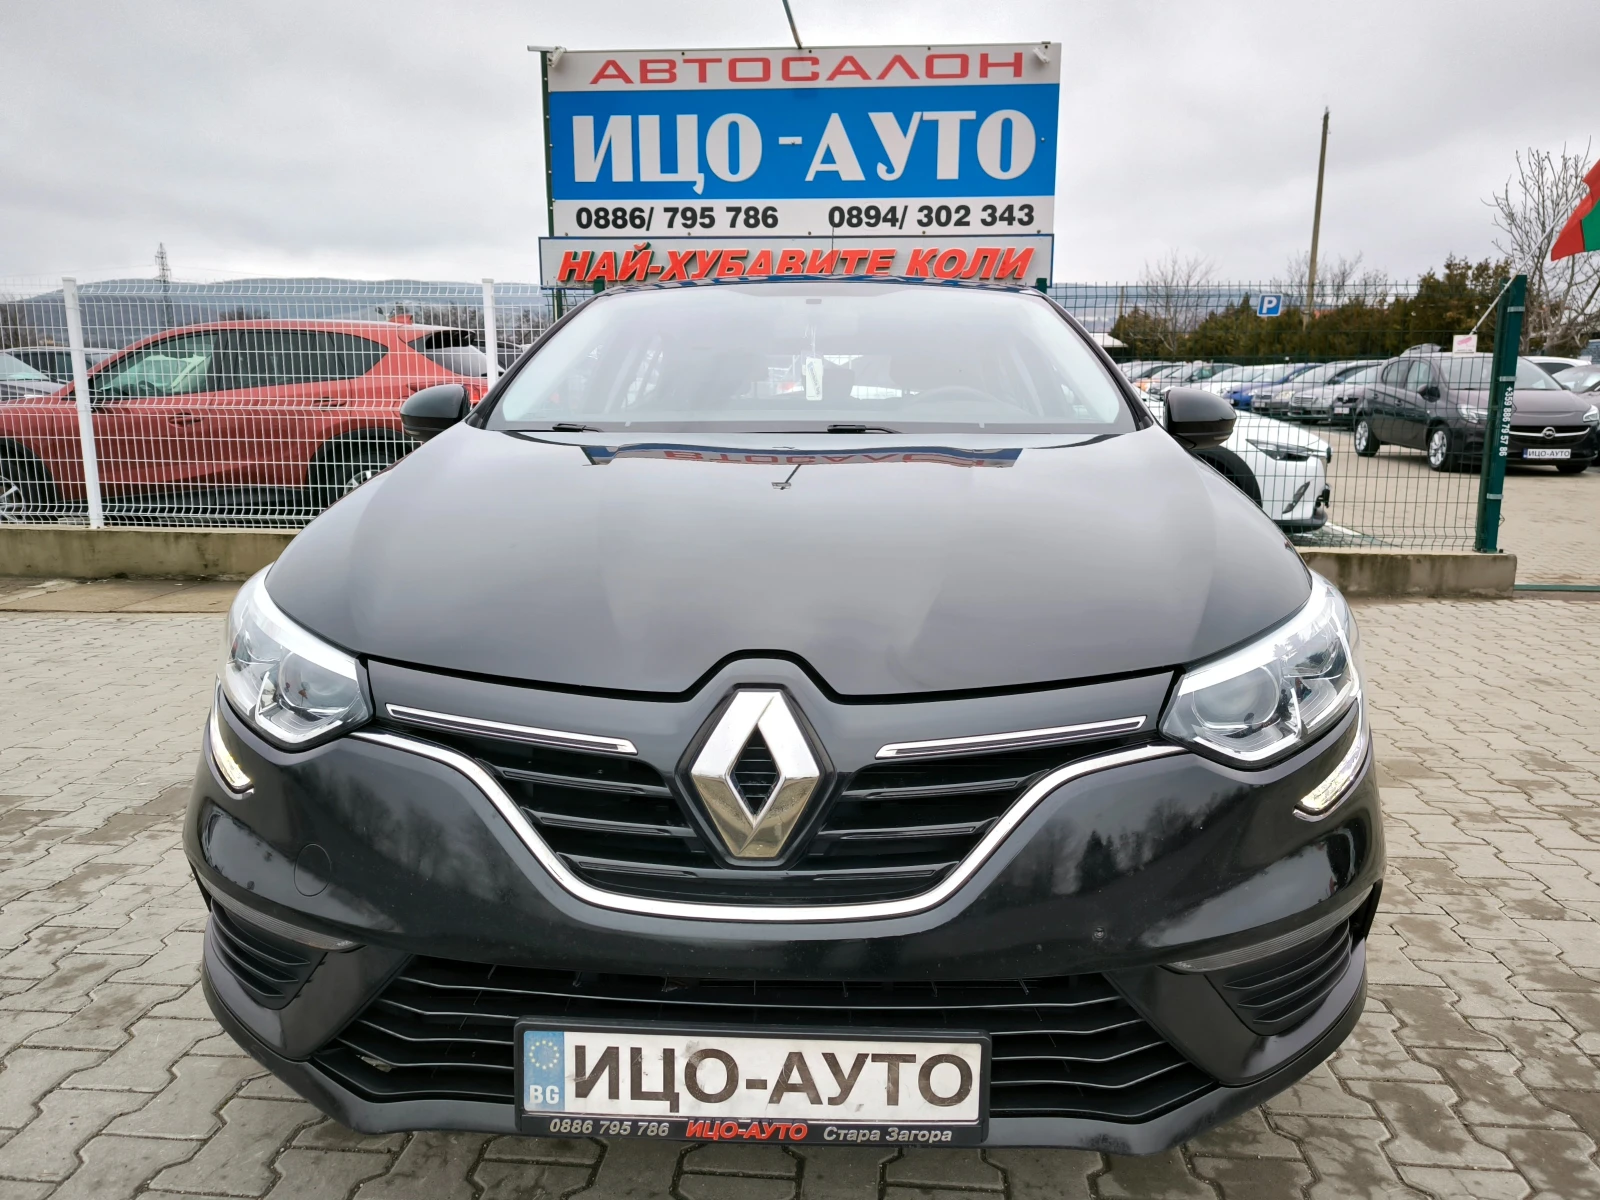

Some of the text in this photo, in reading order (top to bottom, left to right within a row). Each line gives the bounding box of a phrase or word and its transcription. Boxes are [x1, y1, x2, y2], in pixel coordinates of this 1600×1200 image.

[589, 52, 1023, 85] АВТОСАЛОН
[575, 205, 779, 231] 0886/ 795 786
[828, 203, 1035, 230] 0894/ 302 343
[556, 241, 1035, 282] НАЙ-ХУБАВИТЕ КОЛИ
[1262, 296, 1277, 314] P
[574, 1045, 973, 1113] ИЦО-АУТО
[529, 1085, 560, 1105] BG
[549, 1118, 670, 1137] 0886 795 786
[685, 1119, 808, 1141] ИЦО-АУТО
[823, 1126, 952, 1144] Стара Загора
